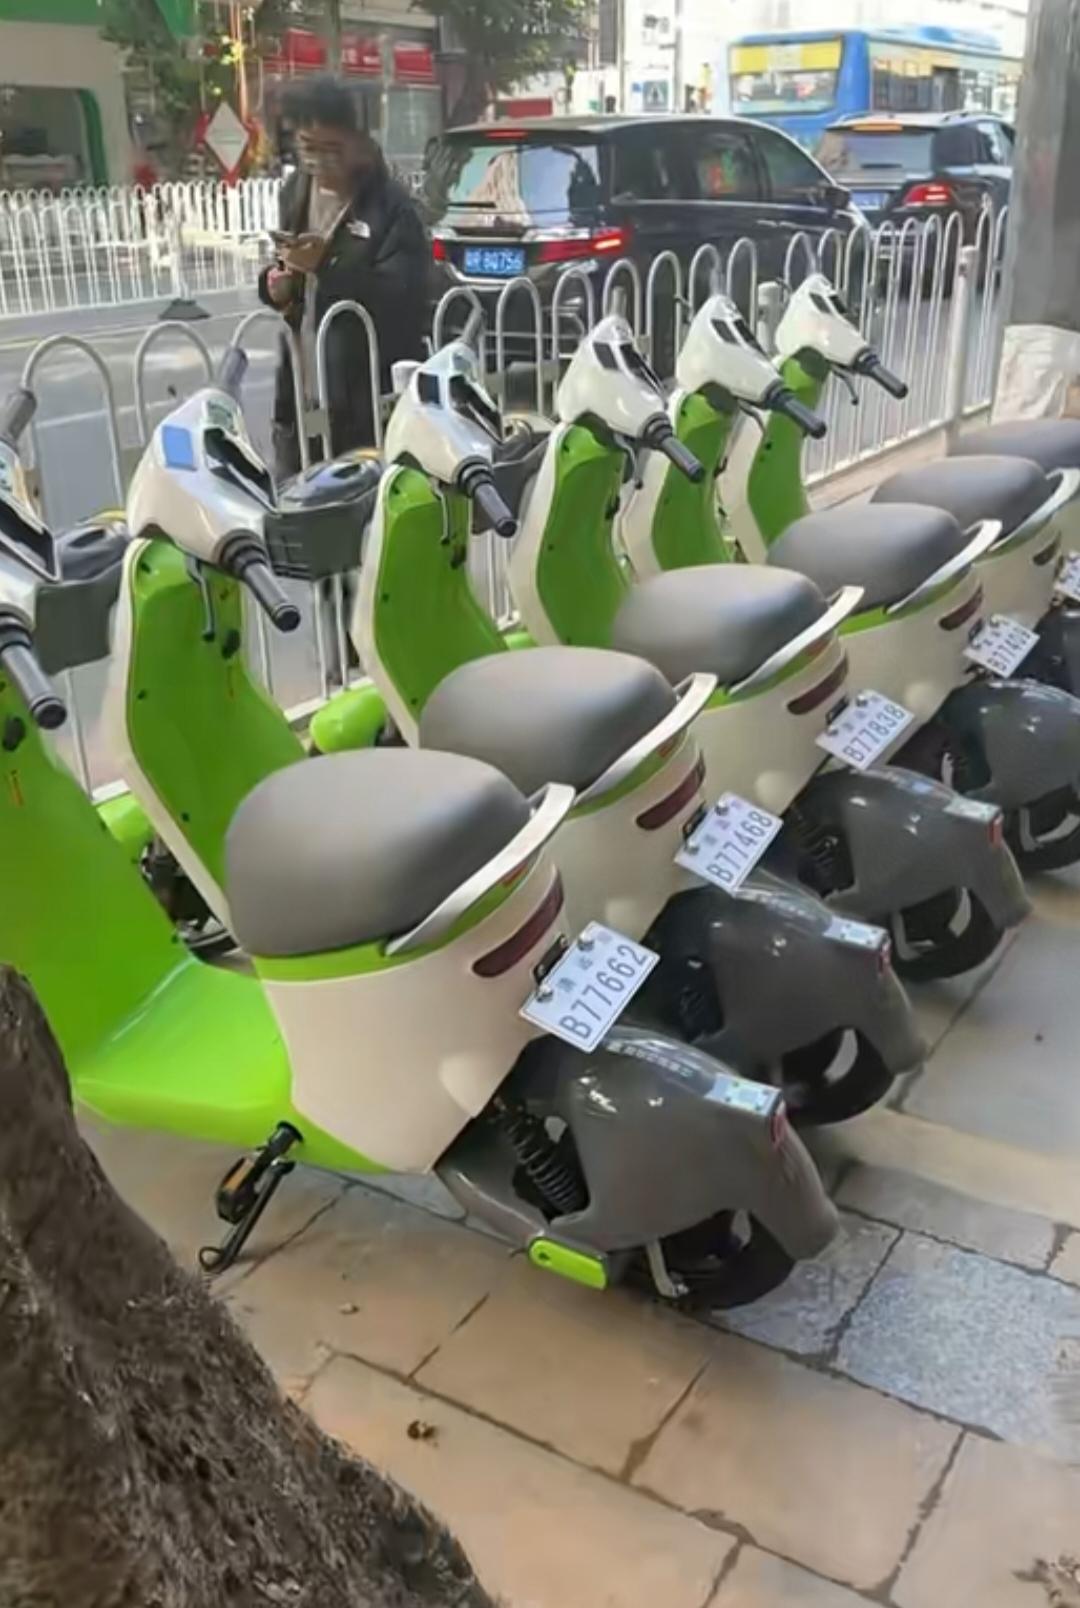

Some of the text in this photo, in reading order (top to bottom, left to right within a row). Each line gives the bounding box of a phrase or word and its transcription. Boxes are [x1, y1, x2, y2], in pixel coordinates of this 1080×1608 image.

[842, 703, 906, 762] B77838
[706, 810, 773, 882] B77468
[559, 943, 647, 1039] B77662
